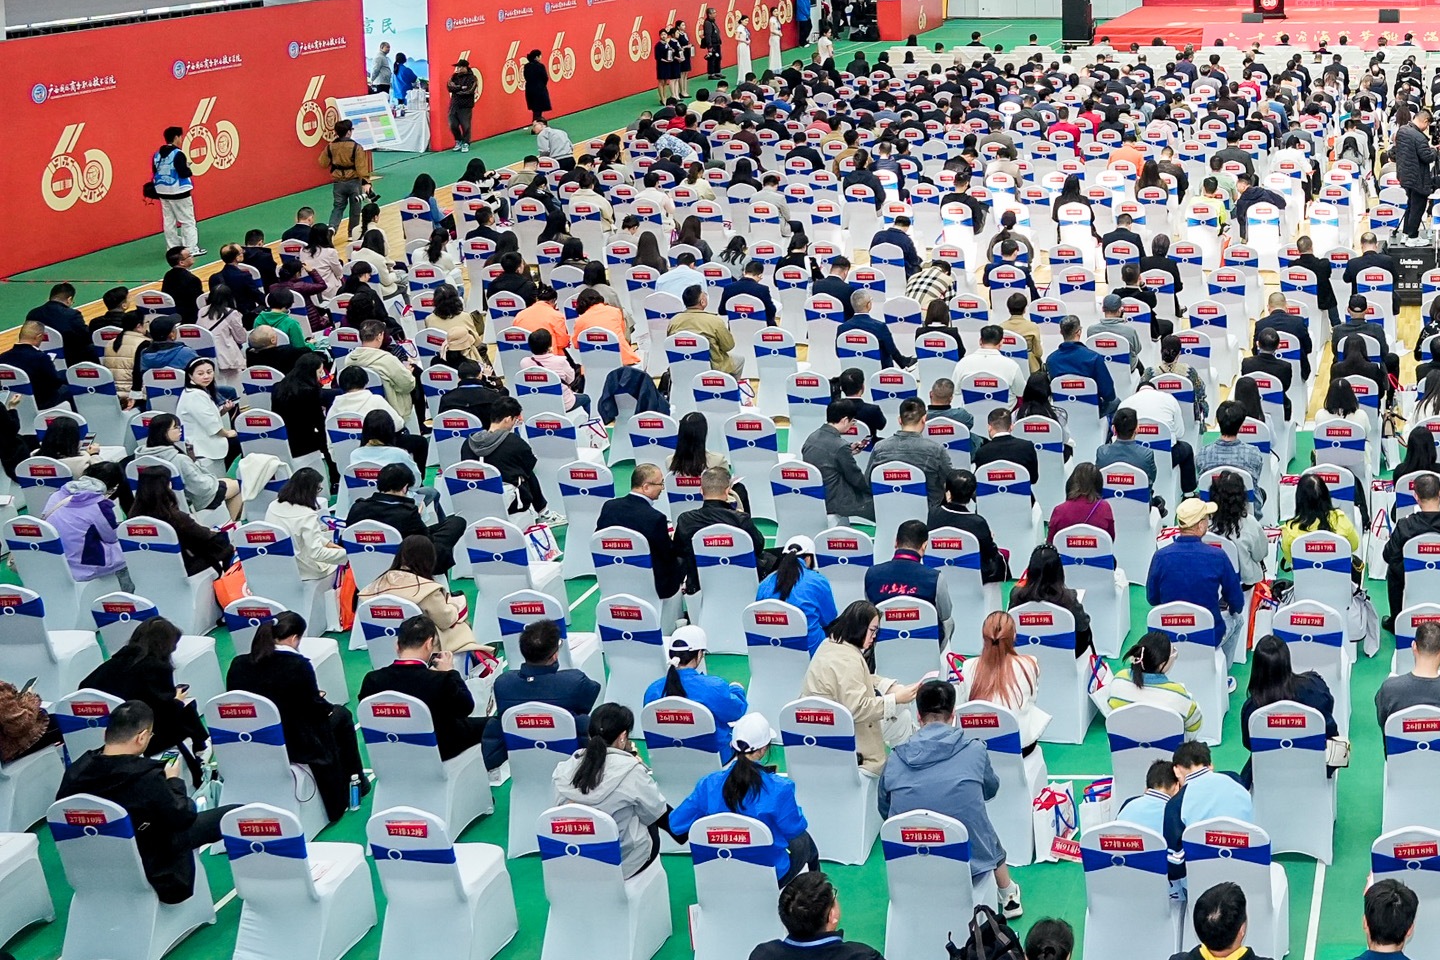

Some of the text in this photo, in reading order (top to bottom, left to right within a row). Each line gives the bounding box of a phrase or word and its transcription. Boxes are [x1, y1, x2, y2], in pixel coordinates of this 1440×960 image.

[1022, 616, 1050, 624] 25排15座
[77, 706, 104, 714] 26排9座
[964, 718, 996, 726] 26排15座
[1270, 718, 1303, 726] 26排17座
[1406, 722, 1438, 730] 26排18座
[243, 825, 277, 833] 27排11座
[390, 827, 424, 837] 27排12座
[554, 824, 591, 833] 27排13座
[711, 834, 747, 843] 27排14座
[905, 833, 941, 841] 27排15座
[1209, 836, 1245, 844] 27排17座
[1104, 840, 1140, 848] 27排16座
[1398, 847, 1434, 856] 27排18座
